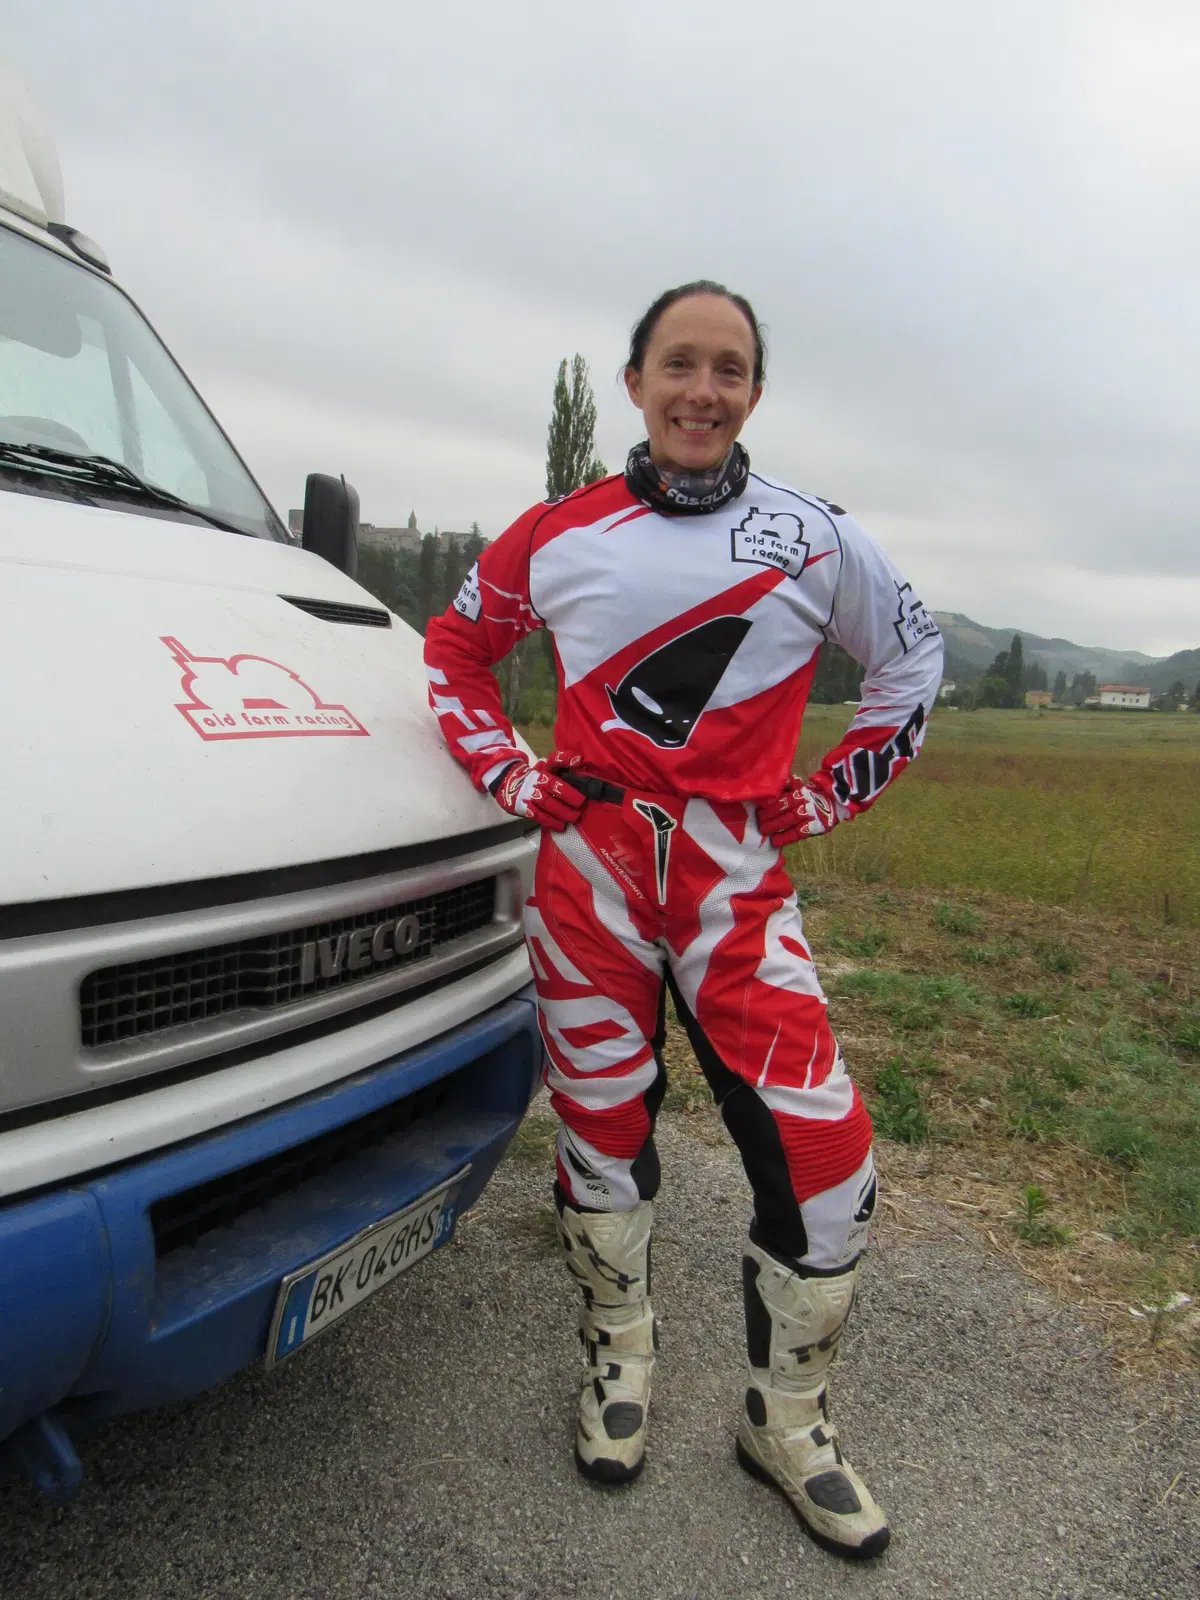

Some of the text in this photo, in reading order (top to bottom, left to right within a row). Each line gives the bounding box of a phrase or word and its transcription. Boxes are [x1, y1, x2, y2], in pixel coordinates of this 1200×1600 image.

[744, 534, 799, 557] old farm
[752, 548, 790, 569] racing
[203, 712, 353, 729] old farm racing
[600, 848, 645, 900] ANNIVERSARY
[301, 914, 421, 985] IVECO
[310, 1204, 441, 1324] BK 048HS
